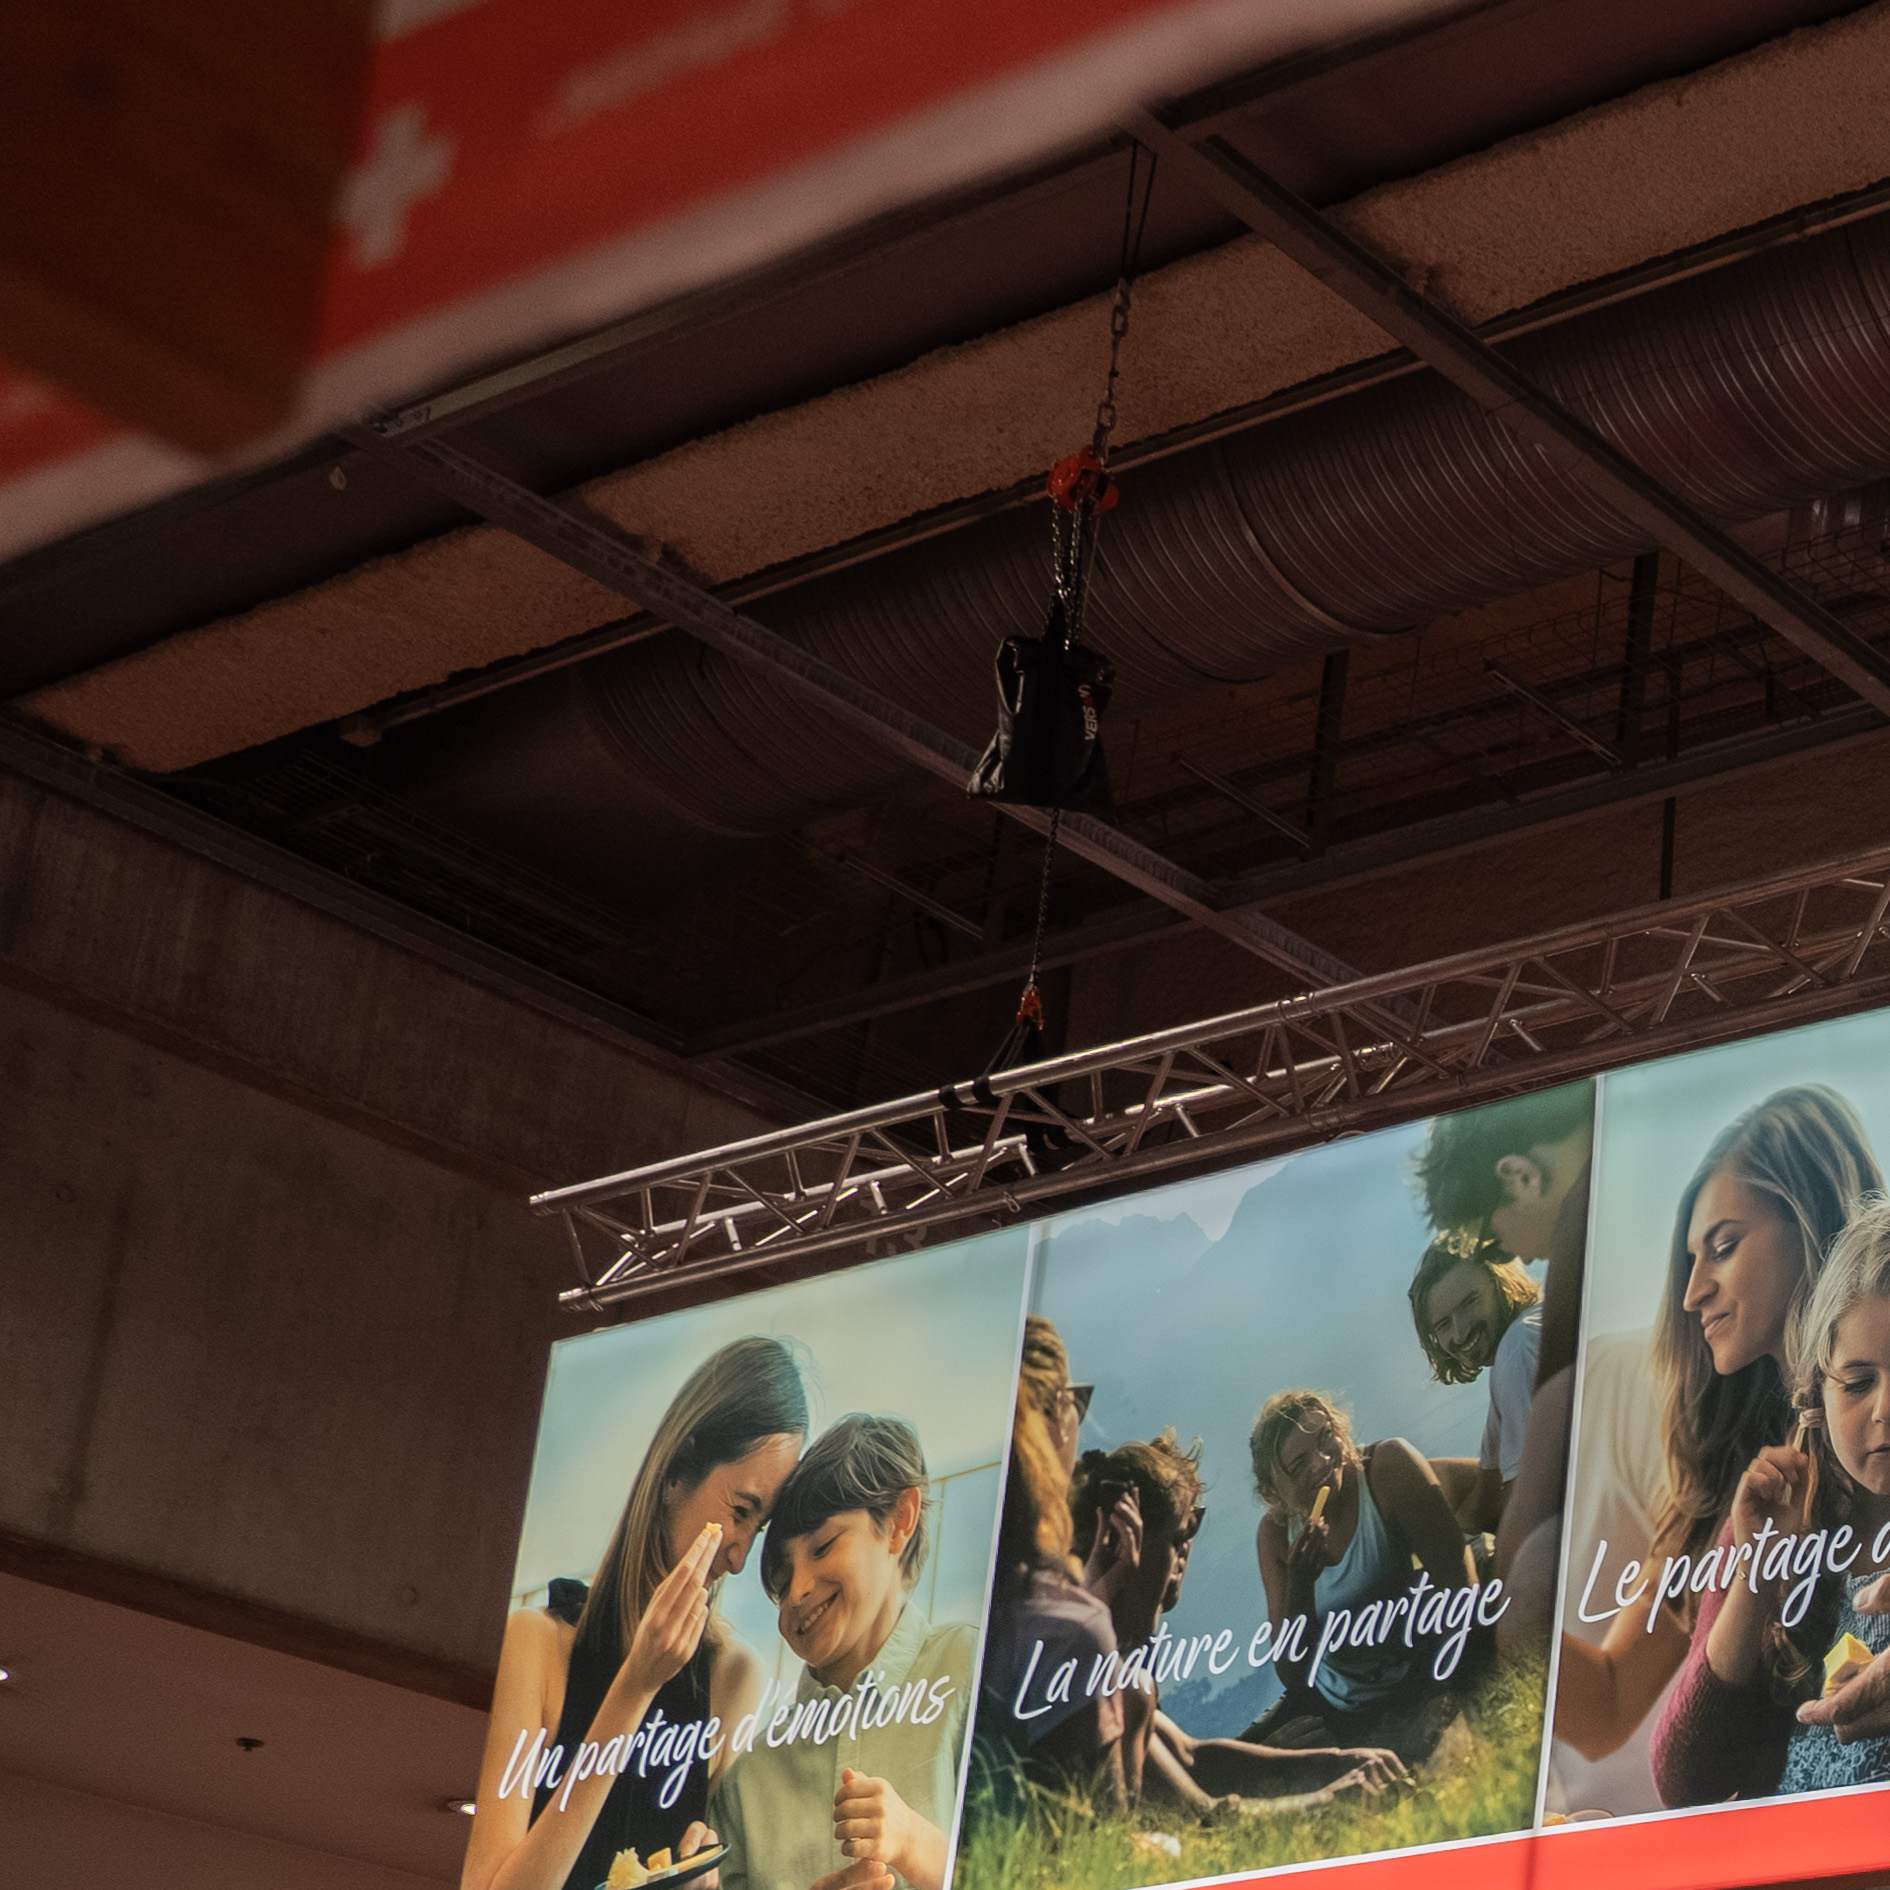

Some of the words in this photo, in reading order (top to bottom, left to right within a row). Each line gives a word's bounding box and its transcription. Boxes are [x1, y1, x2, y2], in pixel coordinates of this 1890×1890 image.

[1014, 1640, 1079, 1720] La
[1085, 1621, 1240, 1697] nature
[1248, 1613, 1309, 1668] en
[1307, 1571, 1511, 1687] partage
[1577, 1539, 1650, 1623] Le
[1646, 1517, 1862, 1634] partage
[498, 1727, 564, 1800] Un
[559, 1709, 727, 1812] partage
[731, 1670, 957, 1753] d'émotions
